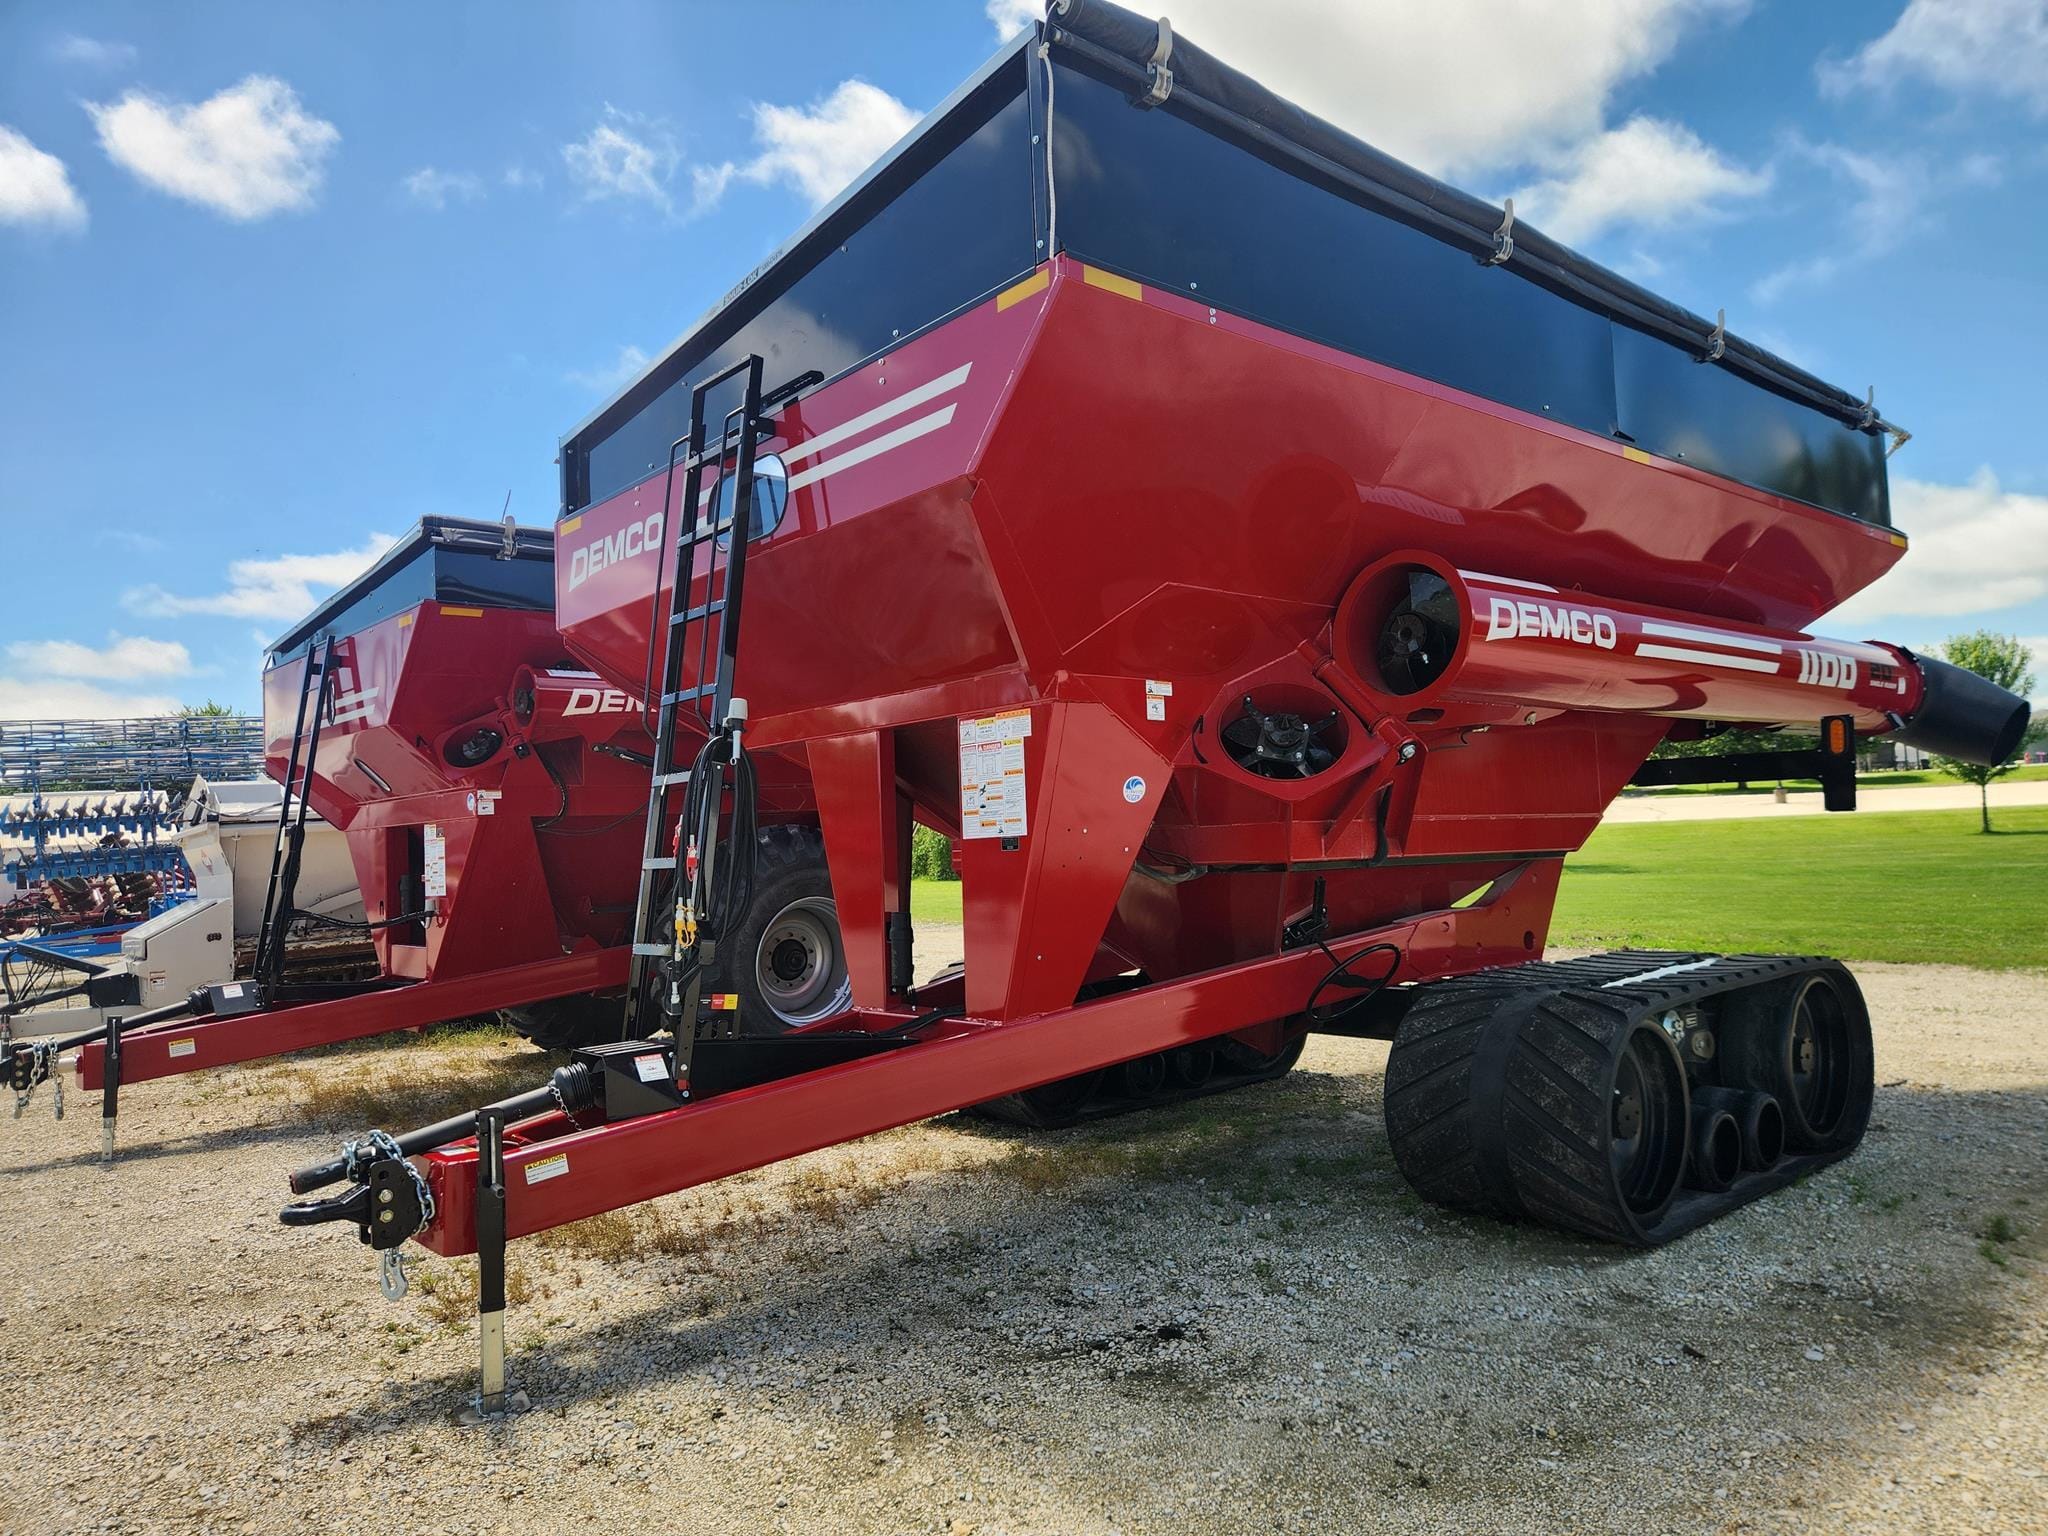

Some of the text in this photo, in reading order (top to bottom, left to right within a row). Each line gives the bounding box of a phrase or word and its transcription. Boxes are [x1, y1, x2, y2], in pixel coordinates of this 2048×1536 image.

[569, 512, 664, 592] DEMCO
[1485, 598, 1617, 650] DEMCO
[1797, 649, 1857, 690] 1100
[533, 1154, 565, 1168] CAUTION
